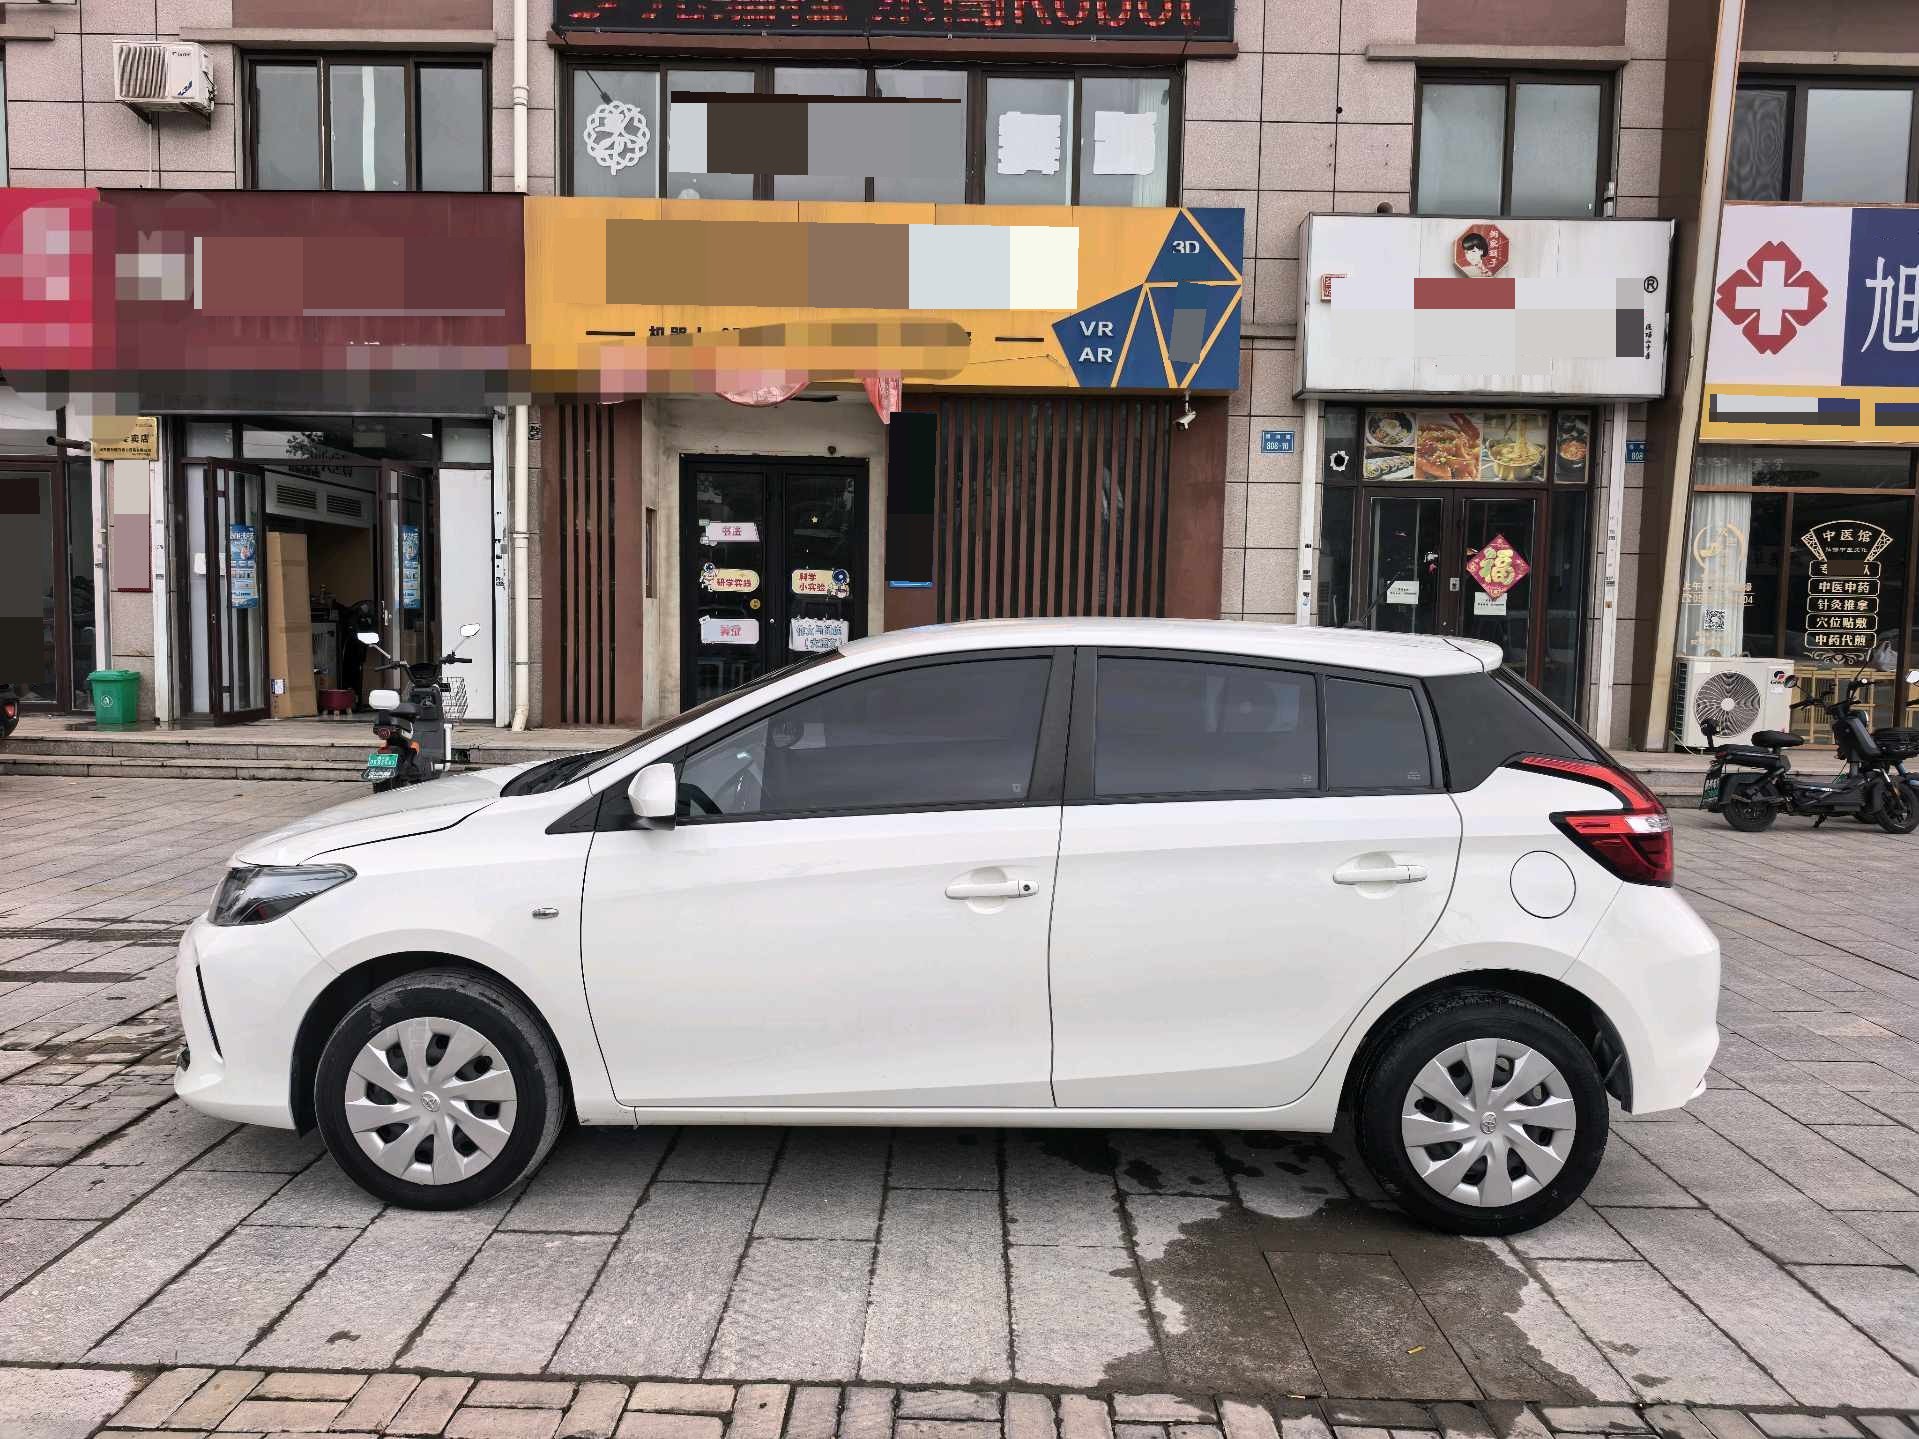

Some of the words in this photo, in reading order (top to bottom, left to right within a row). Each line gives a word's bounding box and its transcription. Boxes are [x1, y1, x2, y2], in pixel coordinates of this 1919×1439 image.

[1172, 240, 1200, 254] 3D
[1079, 320, 1115, 337] VR
[1078, 347, 1114, 363] AR
[1822, 529, 1873, 543] 中医馆
[1818, 581, 1870, 594] 中医中药
[1817, 598, 1869, 611] 针灸推拿
[1816, 616, 1868, 629] 穴位贴敷
[1815, 634, 1867, 646] 中药代煎
